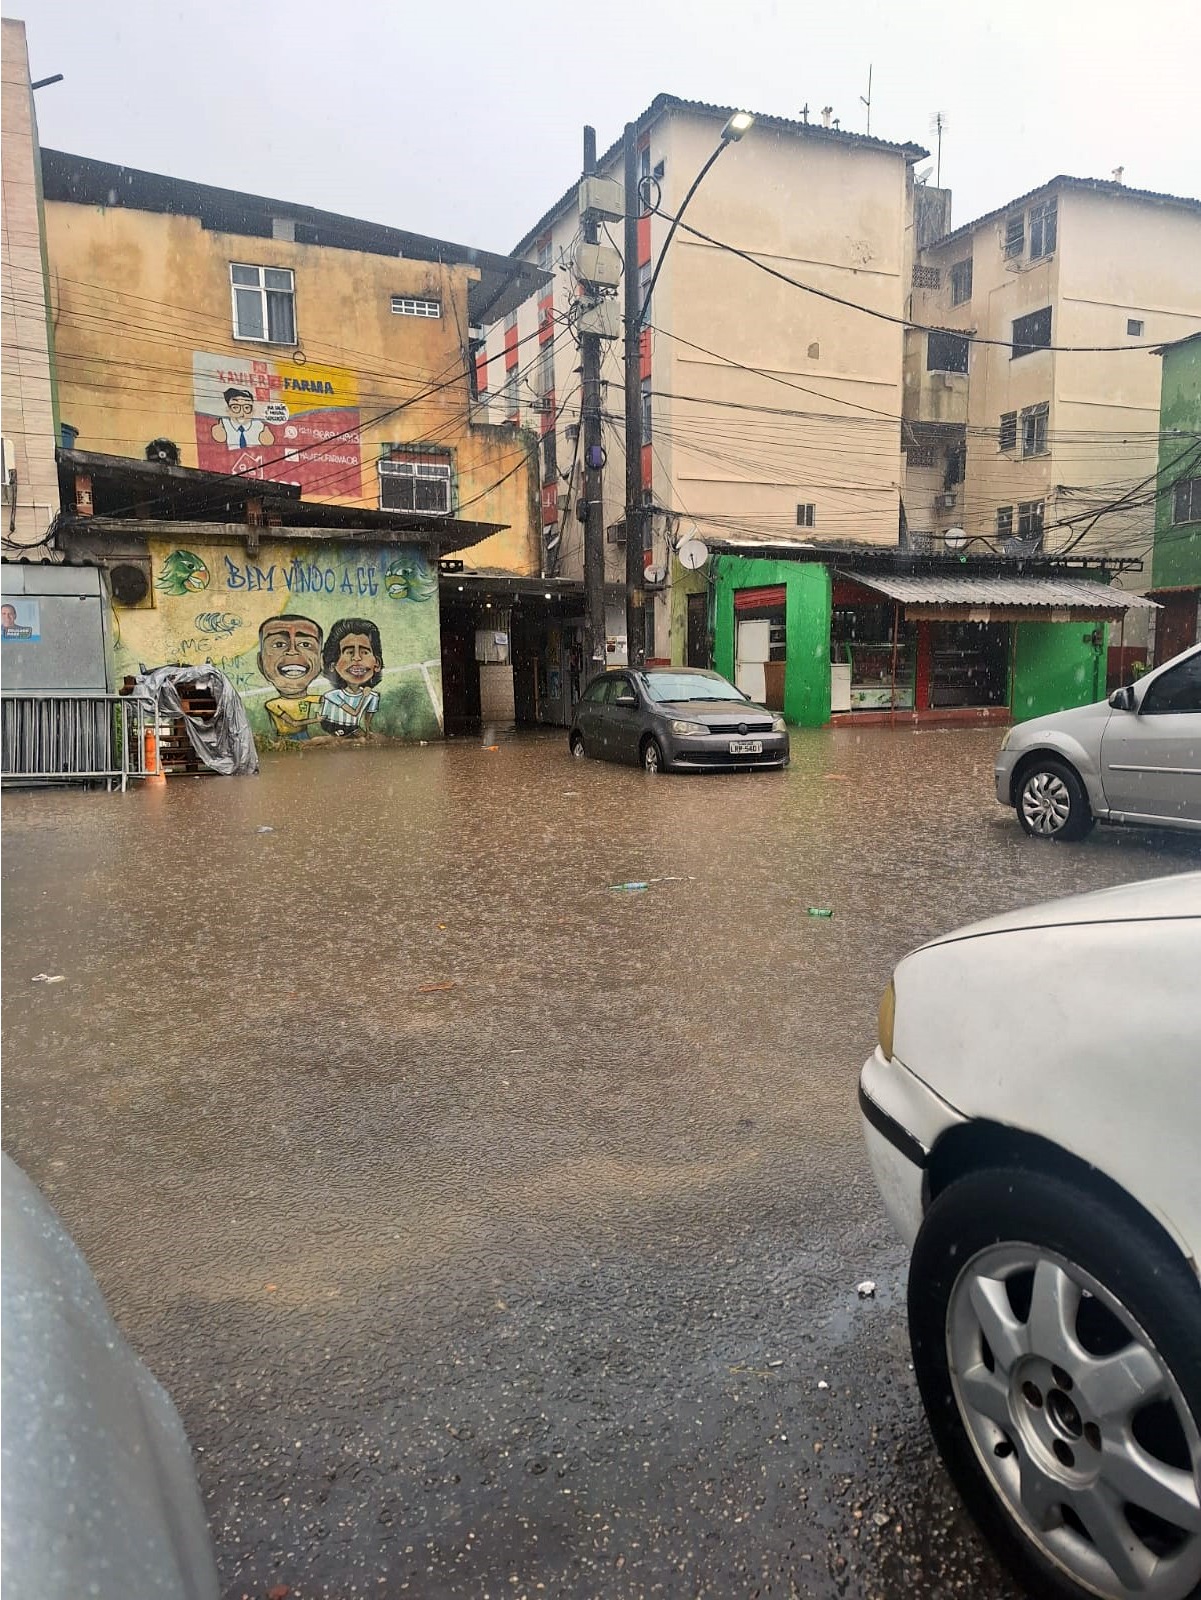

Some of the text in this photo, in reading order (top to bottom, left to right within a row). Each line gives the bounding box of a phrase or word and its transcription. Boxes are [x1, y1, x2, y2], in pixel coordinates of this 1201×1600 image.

[284, 377, 335, 395] FARMA
[224, 554, 276, 591] BEM
[282, 557, 336, 593] VINDO
